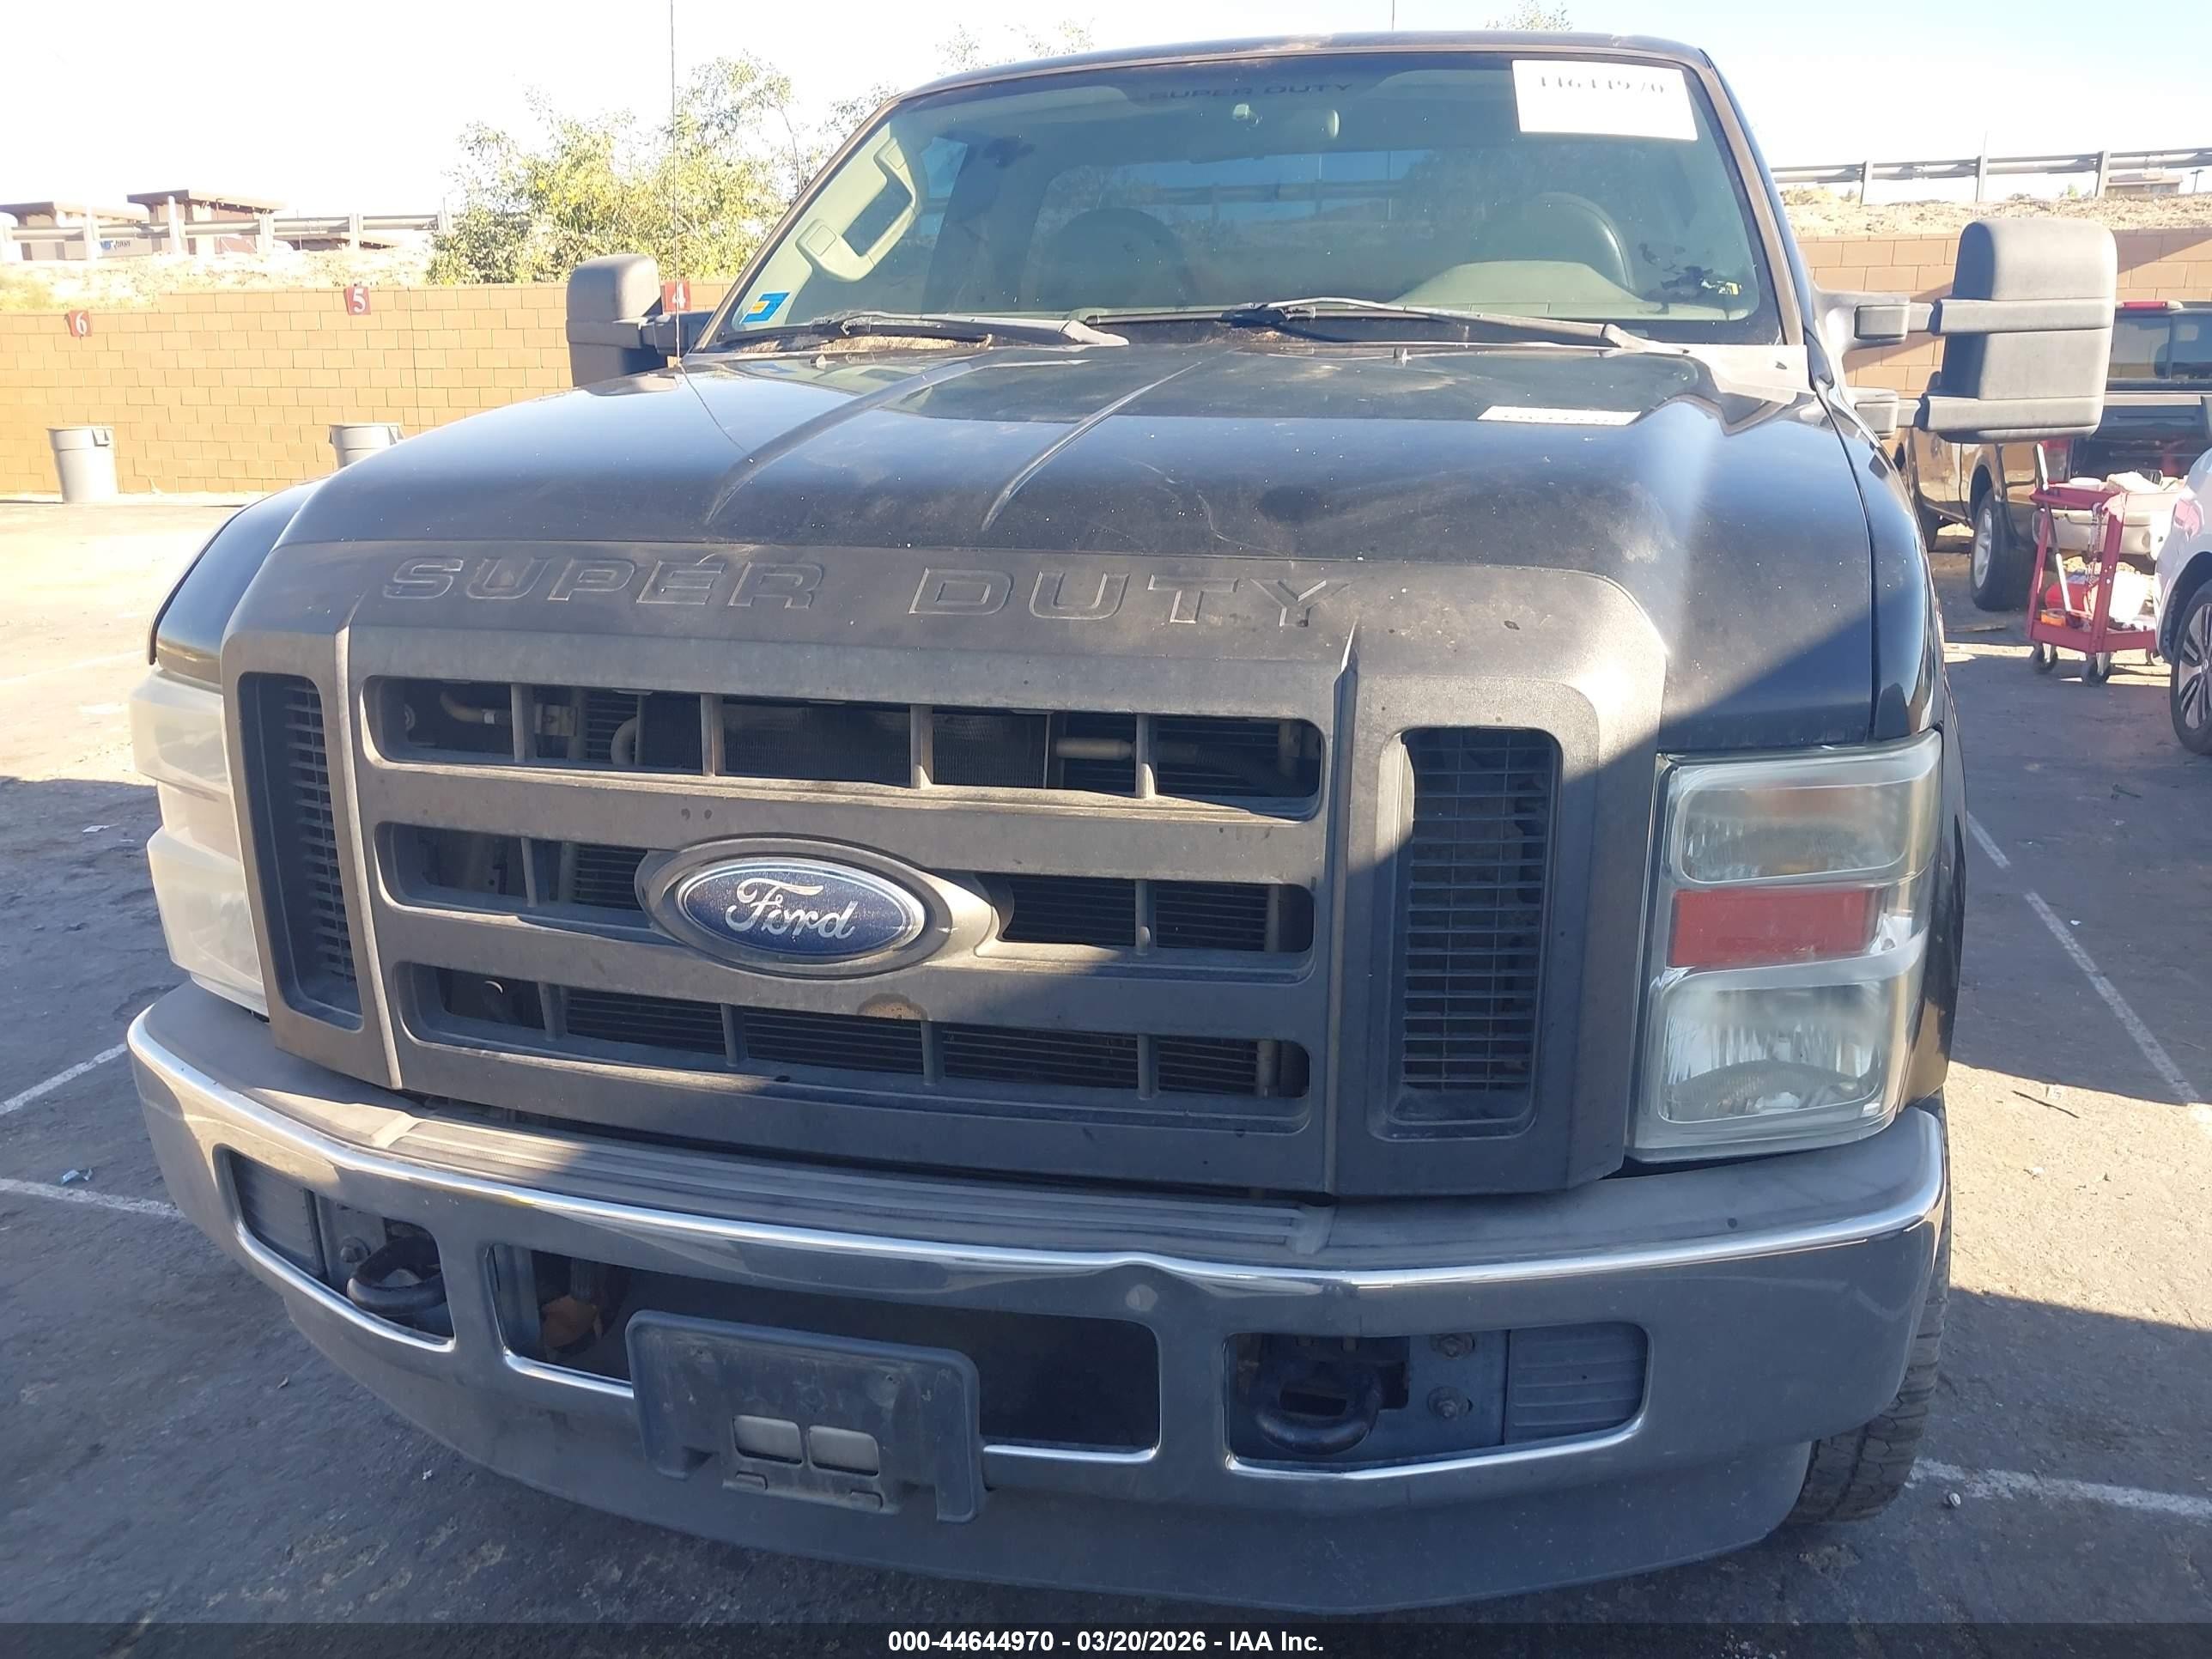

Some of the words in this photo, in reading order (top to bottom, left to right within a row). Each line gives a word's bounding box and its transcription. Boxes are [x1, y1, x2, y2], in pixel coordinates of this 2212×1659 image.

[1264, 82, 1353, 94] DUTY
[352, 288, 366, 313] 5
[672, 283, 687, 309] 4
[76, 312, 88, 334] 6
[383, 556, 824, 610] SUPER
[908, 567, 1352, 628] DUTY
[725, 878, 859, 939] Ford
